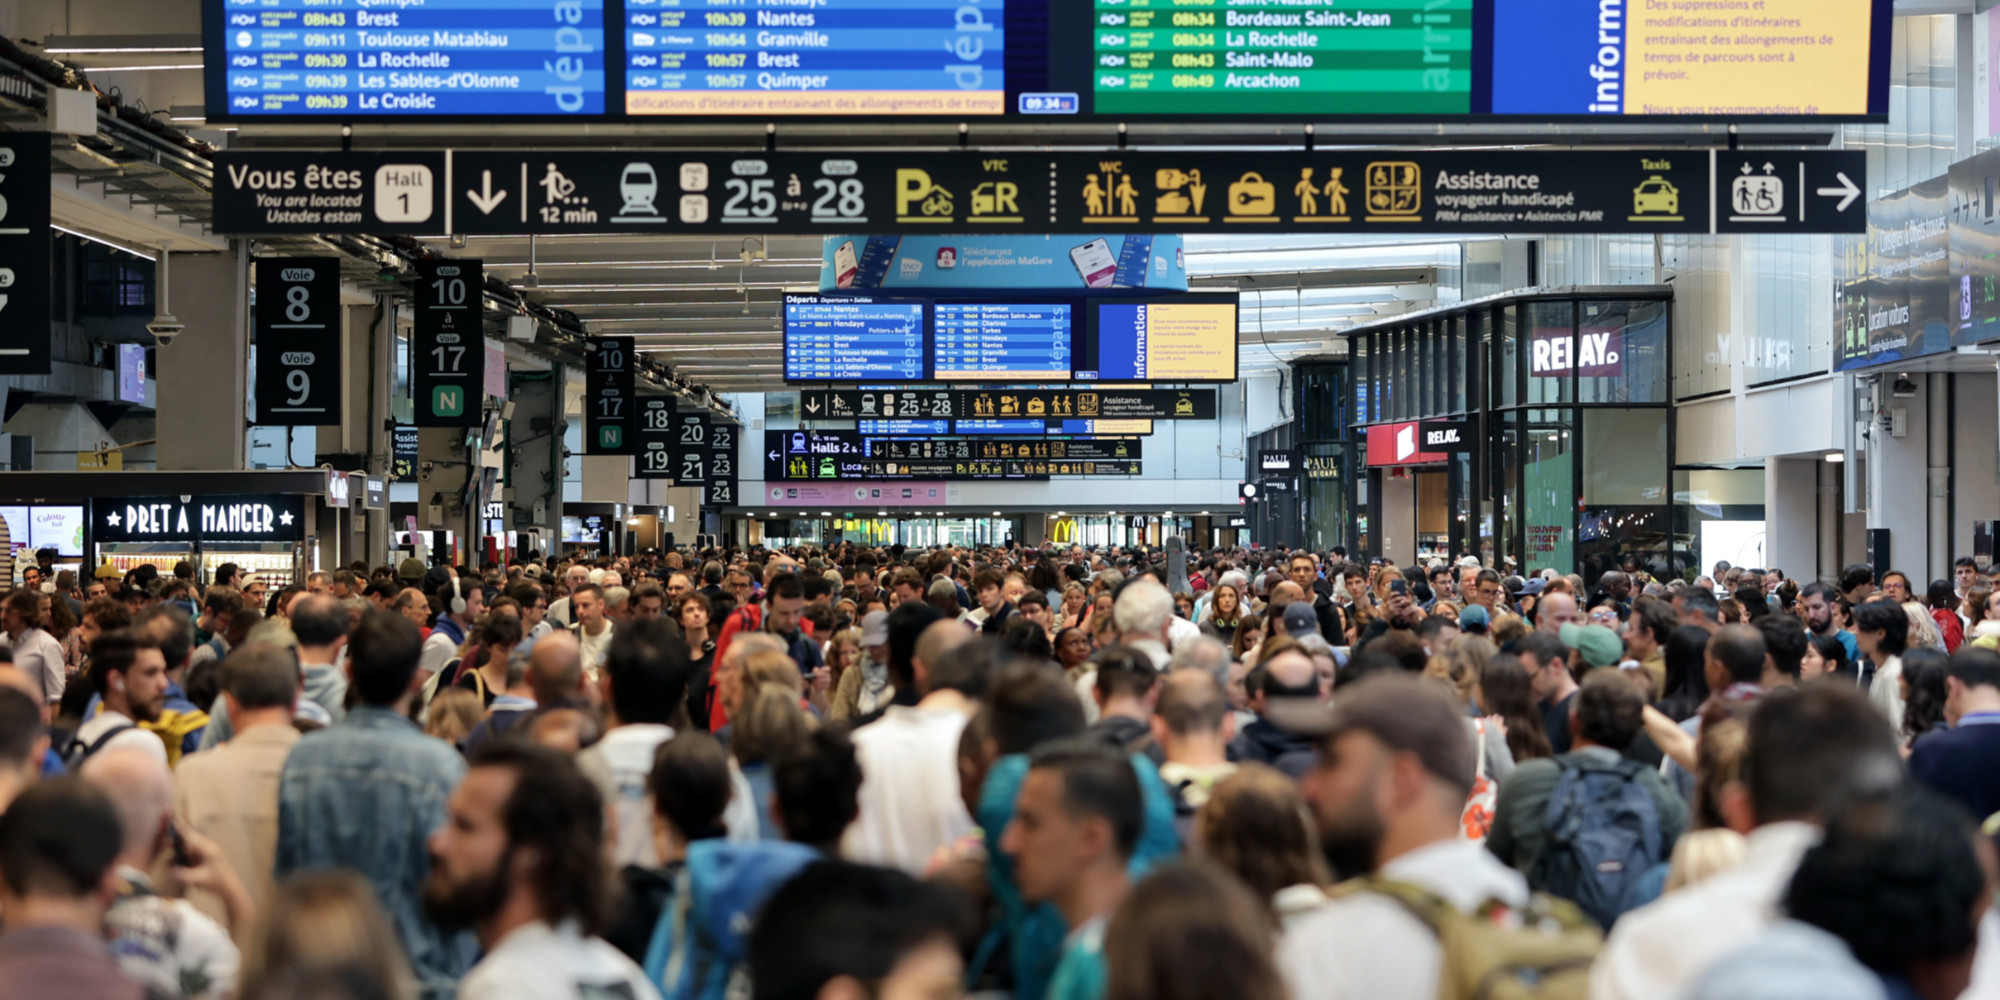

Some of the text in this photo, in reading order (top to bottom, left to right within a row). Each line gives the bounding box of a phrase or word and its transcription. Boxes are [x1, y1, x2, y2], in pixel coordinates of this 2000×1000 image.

[1672, 1, 1749, 12] suppressions
[1752, 1, 1765, 10] et
[303, 12, 346, 26] 08h43
[357, 10, 399, 26] Brest
[705, 12, 746, 26] 10h39
[757, 11, 815, 27] Nantes
[1172, 12, 1215, 26] 08h34
[1225, 10, 1391, 27] Bordeaux Saint-Jean
[1645, 16, 1801, 27] modifications d'itinéraires
[304, 33, 346, 47] 09h11
[357, 31, 508, 47] Toulouse Matabiau
[705, 33, 746, 47] 10h54
[756, 31, 829, 47] Granville
[944, 0, 994, 92] dép
[1172, 33, 1215, 47] 08h34
[1226, 31, 1318, 47] La Rochelle
[1710, 34, 1731, 45] des
[1734, 34, 1815, 48] allongements
[1819, 34, 1833, 45] de
[305, 54, 347, 68] 09h30
[358, 52, 450, 68] La Rochelle
[705, 53, 746, 68] 10h57
[757, 51, 800, 68] Brest
[1172, 53, 1215, 67] 08h43
[1225, 51, 1313, 68] Saint-Malo
[1644, 51, 1794, 66] temps de parcours sont à
[305, 75, 348, 89] 09h39
[358, 72, 519, 89] Les Sables-d'Olonne
[705, 74, 746, 88] 10h57
[757, 72, 829, 91] Quimper
[1225, 72, 1300, 88] Arcachon
[1643, 70, 1690, 82] prévoir.
[306, 95, 348, 109] 09h39
[359, 93, 436, 109] Le Croisic
[737, 162, 762, 173] Voie
[827, 162, 852, 173] Voie
[983, 160, 1008, 172] VTC
[1100, 161, 1122, 173] WC
[1641, 159, 1671, 170] Taxis
[228, 163, 363, 190] Vous êtes
[385, 171, 423, 187] Hall
[690, 177, 698, 188] 2
[1435, 171, 1539, 189] Assistance
[723, 174, 865, 217] 25 à 28
[896, 168, 932, 215] P
[256, 193, 363, 207] You are located
[397, 193, 409, 215] 1
[1435, 192, 1574, 209] voyageur handicapé
[266, 210, 362, 223] Ustedes estan
[540, 207, 598, 223] 12 min
[690, 208, 698, 220] 3
[1435, 210, 1603, 222] PRM assistance Asistencia PMR
[963, 248, 1012, 258] Téléchargez
[962, 256, 1053, 267] l'application MaGare
[285, 270, 311, 280] Voie
[439, 268, 457, 276] Voie
[431, 278, 466, 304] 10
[286, 286, 311, 322] 8
[786, 295, 817, 304] Départs
[834, 304, 859, 312] Nantes
[444, 312, 452, 323] à
[834, 319, 865, 328] Hendaye
[439, 335, 457, 343] Voie
[1049, 307, 1067, 371] départs
[1134, 305, 1145, 379] information
[901, 314, 919, 379] départs
[285, 354, 311, 364] Voie
[431, 346, 466, 371] 17
[598, 351, 623, 368] 10
[286, 369, 311, 406] 9
[440, 392, 456, 410] N
[598, 398, 623, 416] 17
[900, 400, 919, 414] 25
[932, 400, 951, 414] 28
[643, 410, 669, 428] 18
[605, 430, 616, 443] N
[681, 425, 703, 442] 20
[712, 434, 731, 447] 22
[811, 443, 839, 454] Halls
[843, 443, 849, 454] 2
[934, 447, 969, 456] 25 28
[643, 451, 669, 469] 19
[1263, 455, 1289, 463] PAUL
[1306, 457, 1337, 470] PAUL
[682, 462, 703, 478] 21
[712, 460, 731, 473] 23
[841, 463, 861, 471] Loca
[712, 487, 731, 500] 24
[36, 513, 65, 523] Colour
[126, 504, 171, 533] PRET
[202, 504, 274, 533] MANGER
